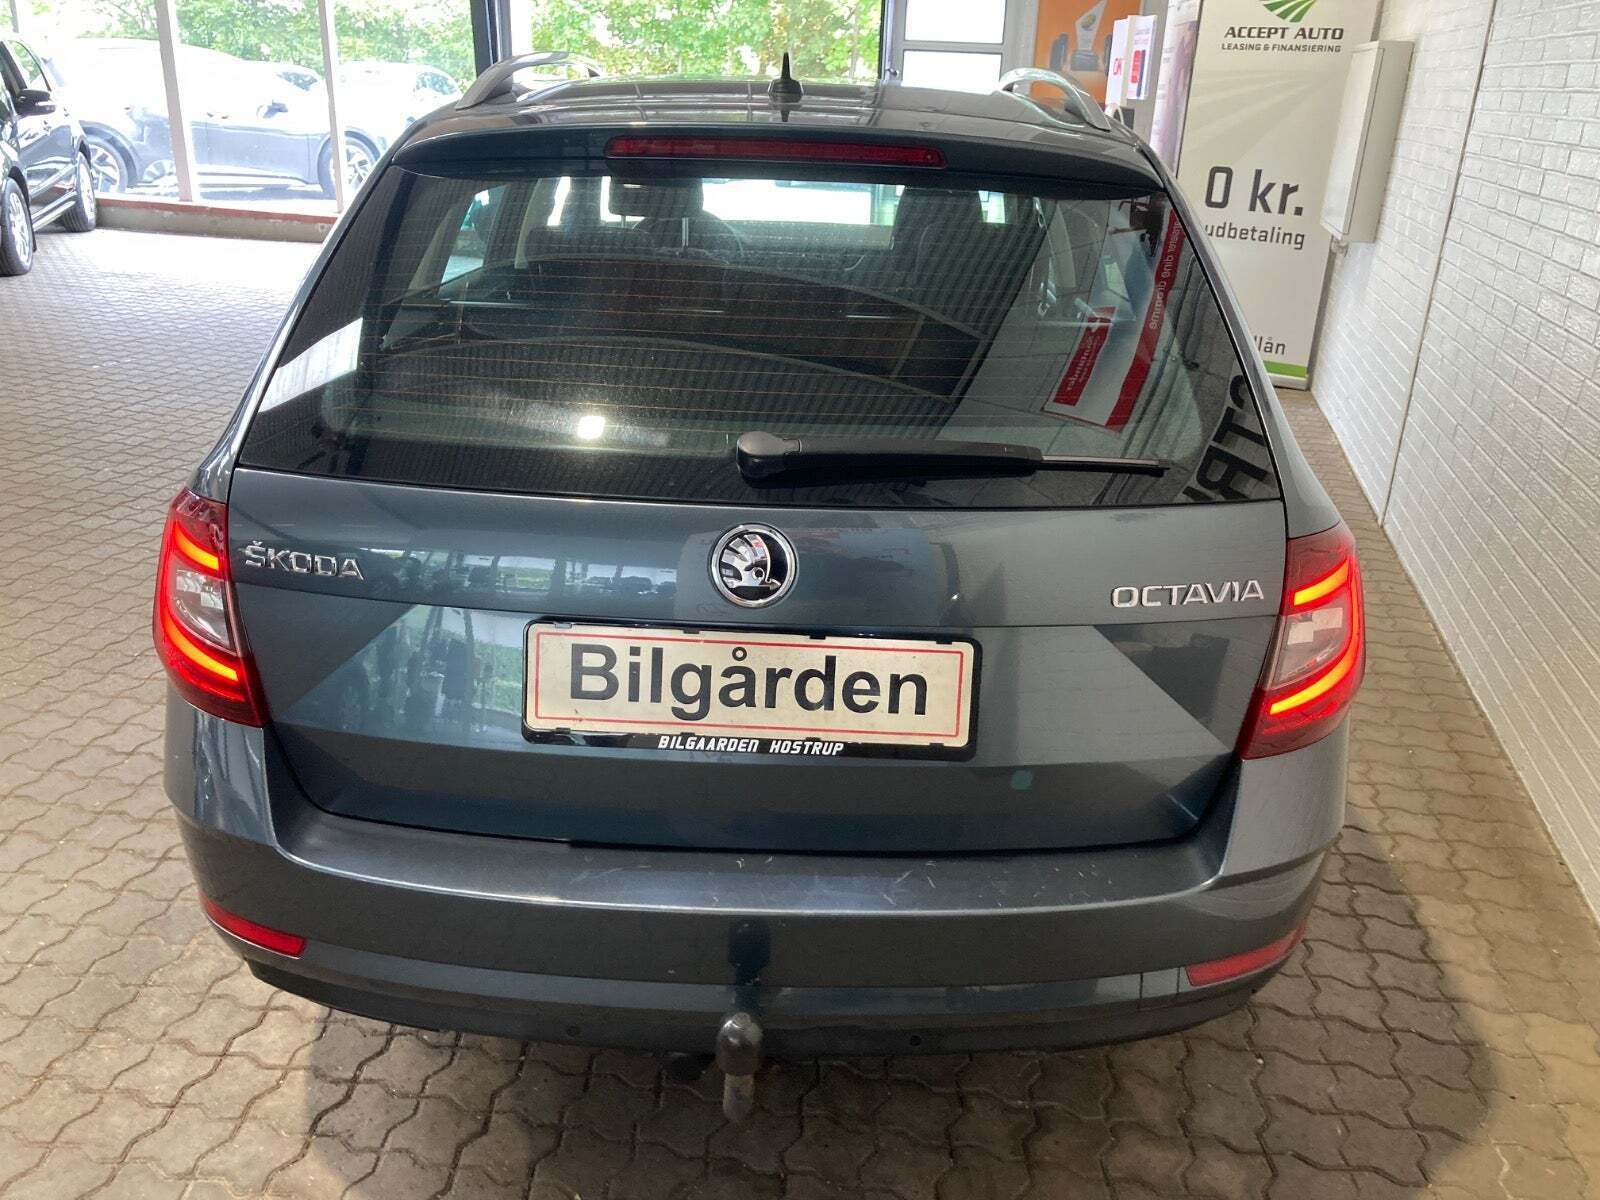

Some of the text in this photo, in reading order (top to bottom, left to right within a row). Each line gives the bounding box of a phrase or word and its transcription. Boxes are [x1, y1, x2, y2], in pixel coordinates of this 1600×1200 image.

[1224, 26, 1344, 40] ACCEPT AUTO
[1221, 43, 1262, 51] LEASING
[1272, 44, 1341, 53] FINANSIERING
[1205, 166, 1304, 216] 0 kr.
[1205, 222, 1305, 250] udbetaling
[244, 540, 365, 581] ŠKODA
[1111, 579, 1265, 608] OCTAVIA
[570, 643, 927, 721] Bilgården
[657, 735, 845, 756] BILGAARDEN HOSTRUP
